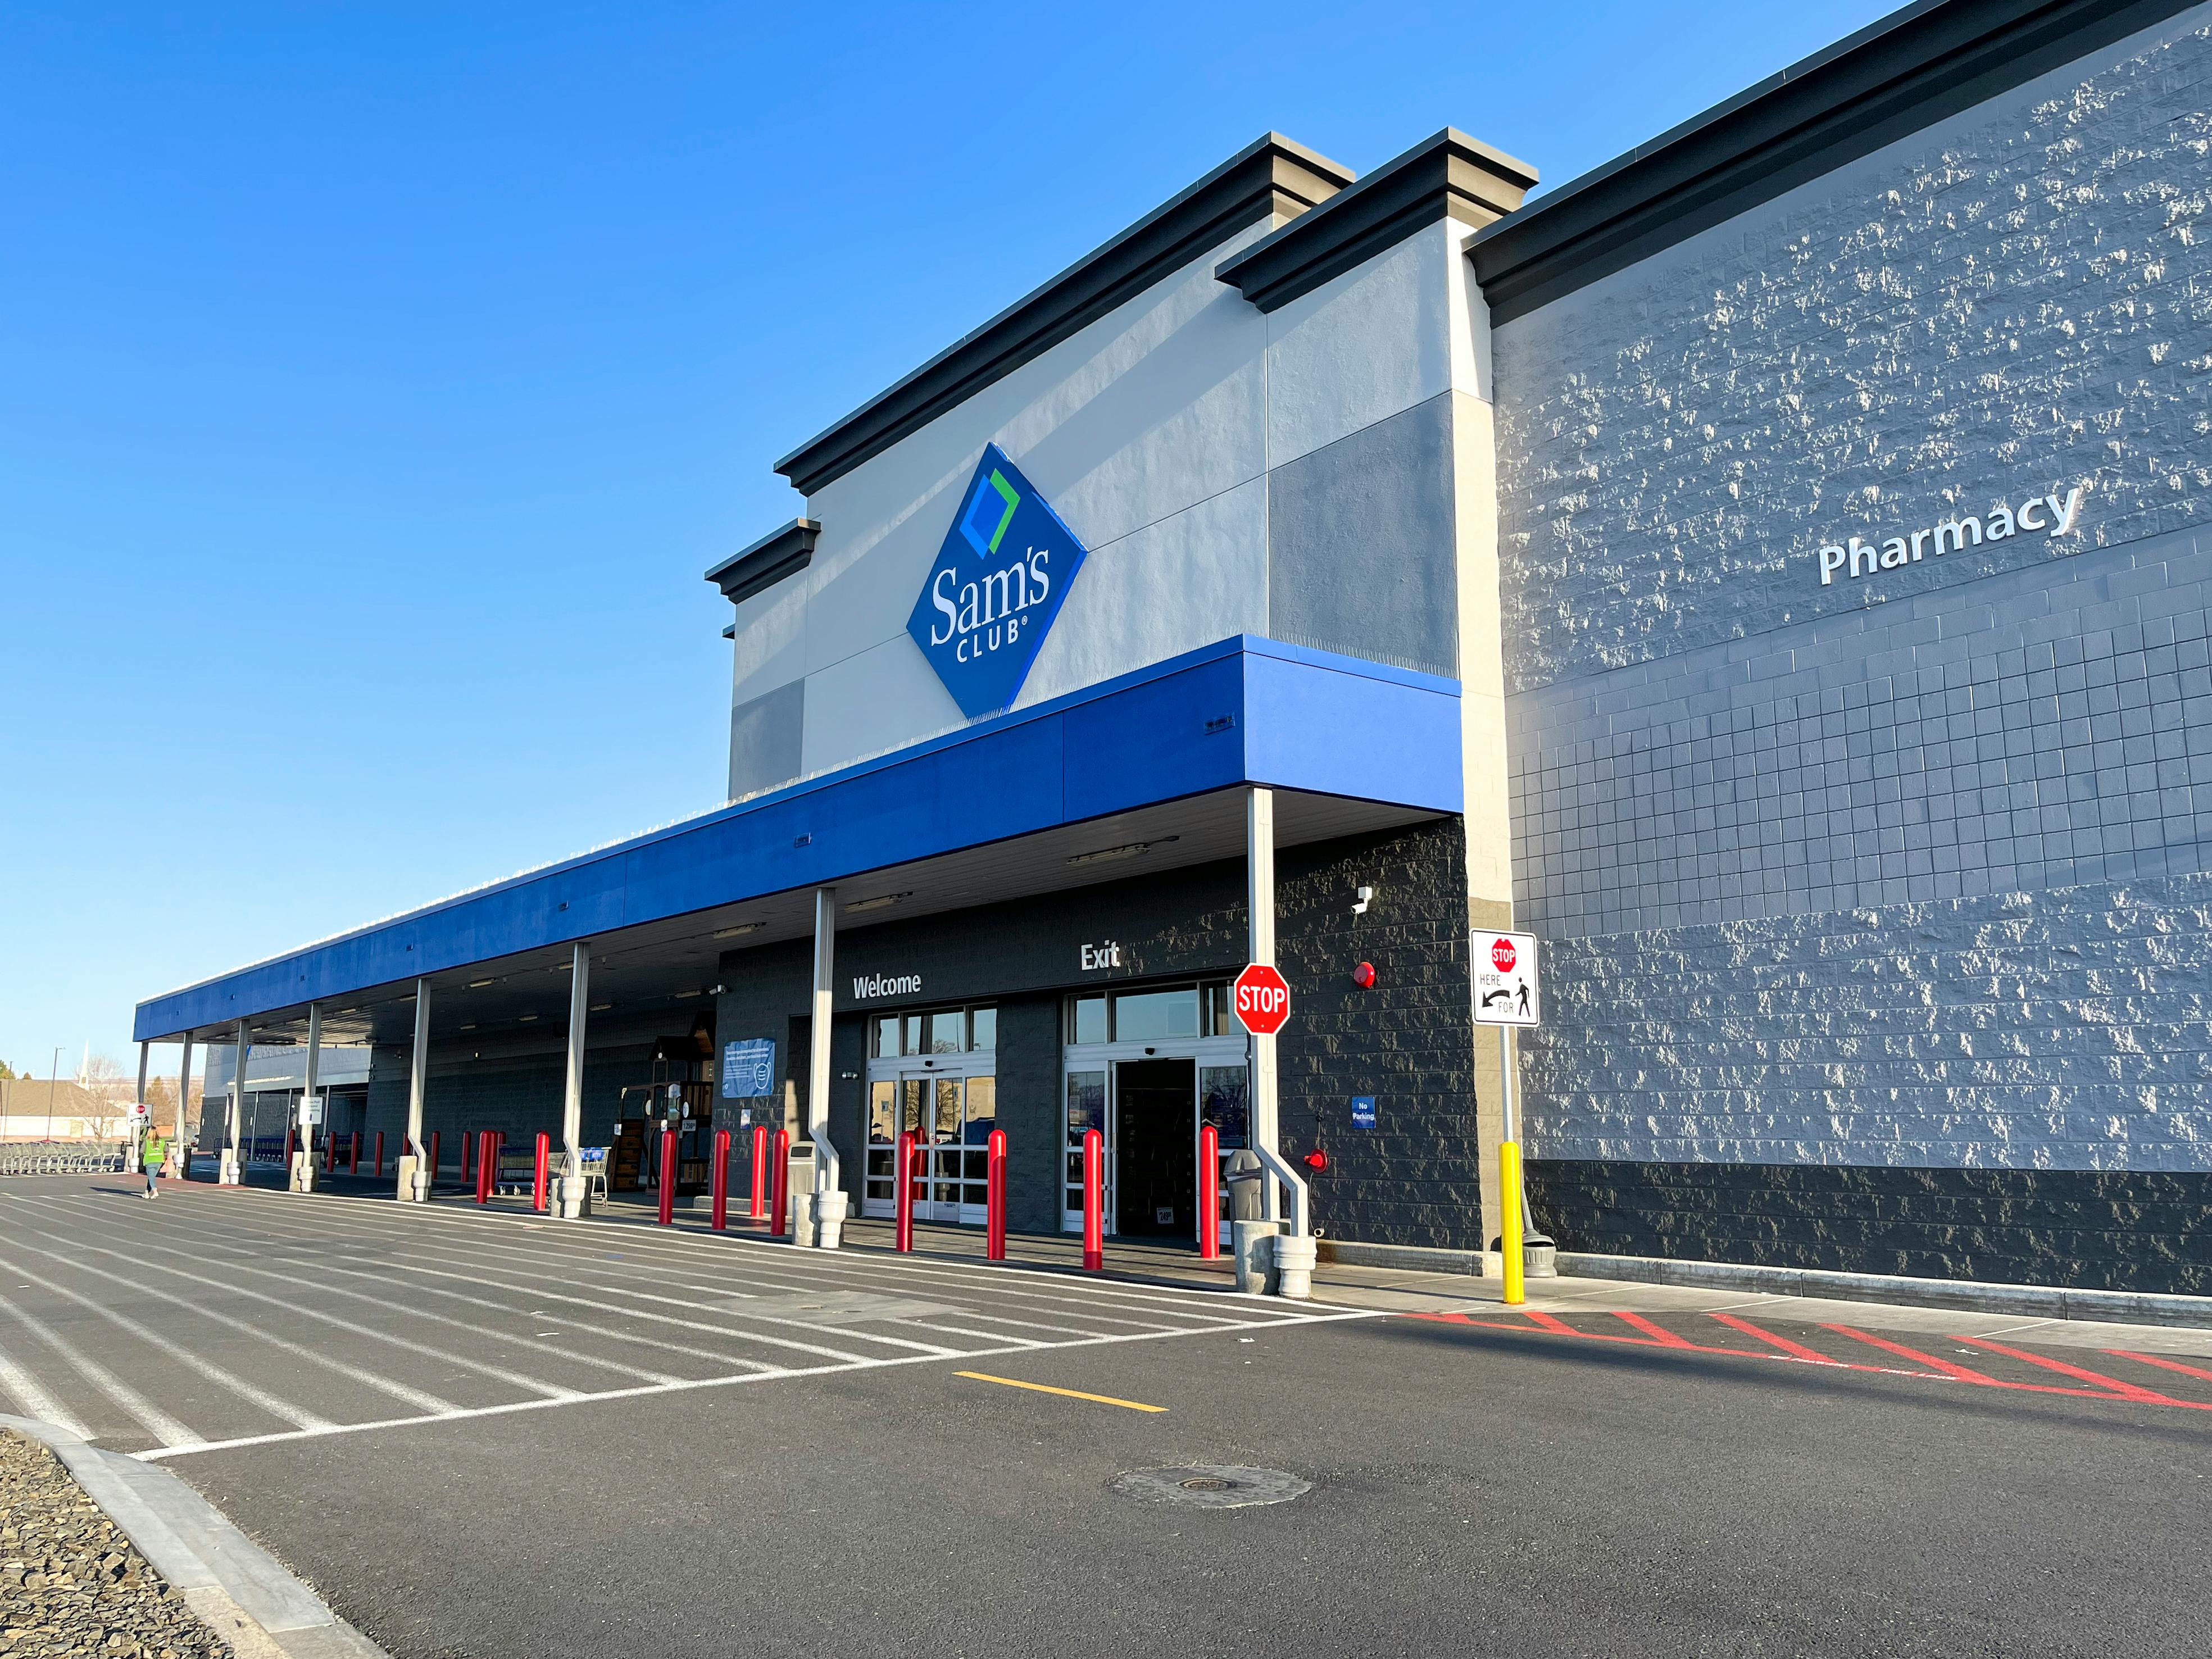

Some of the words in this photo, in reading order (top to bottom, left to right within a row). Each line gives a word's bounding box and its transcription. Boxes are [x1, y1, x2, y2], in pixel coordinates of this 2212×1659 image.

[1820, 488, 2079, 585] Pharmacy
[931, 546, 1049, 646] Sam's
[1082, 939, 1120, 971] Exit
[1492, 948, 1515, 963] STOP
[853, 973, 921, 999] Welcome
[1480, 974, 1501, 986] HERE
[1238, 985, 1286, 1013] STOP
[1498, 1002, 1514, 1013] FOR
[1352, 1112, 1374, 1121] Parking
